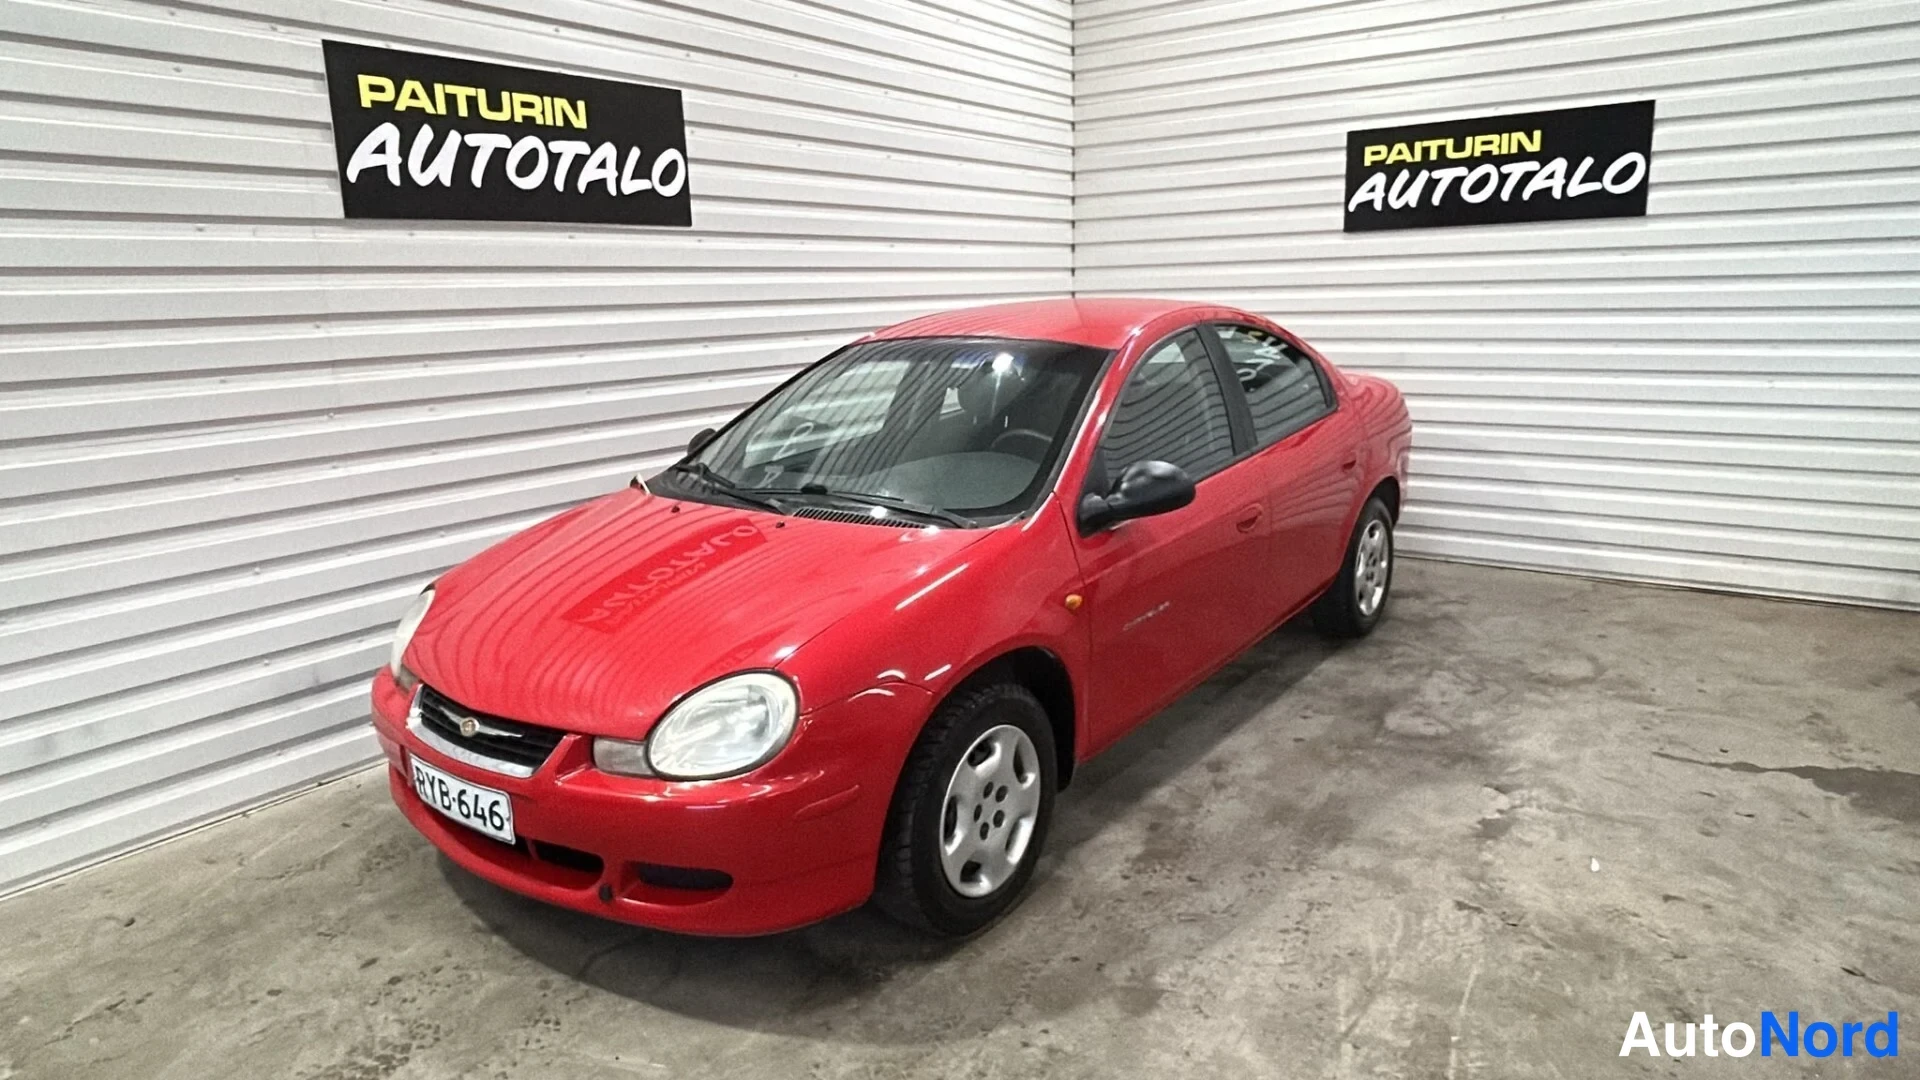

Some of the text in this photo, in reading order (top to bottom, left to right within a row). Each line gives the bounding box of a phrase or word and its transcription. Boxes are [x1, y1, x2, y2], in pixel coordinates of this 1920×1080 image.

[357, 74, 588, 129] PAITURIN
[346, 121, 686, 197] AUTOTALO
[1364, 130, 1542, 166] PAITURIN
[1348, 152, 1646, 212] AUTOTALO
[415, 766, 504, 831] RYB-646
